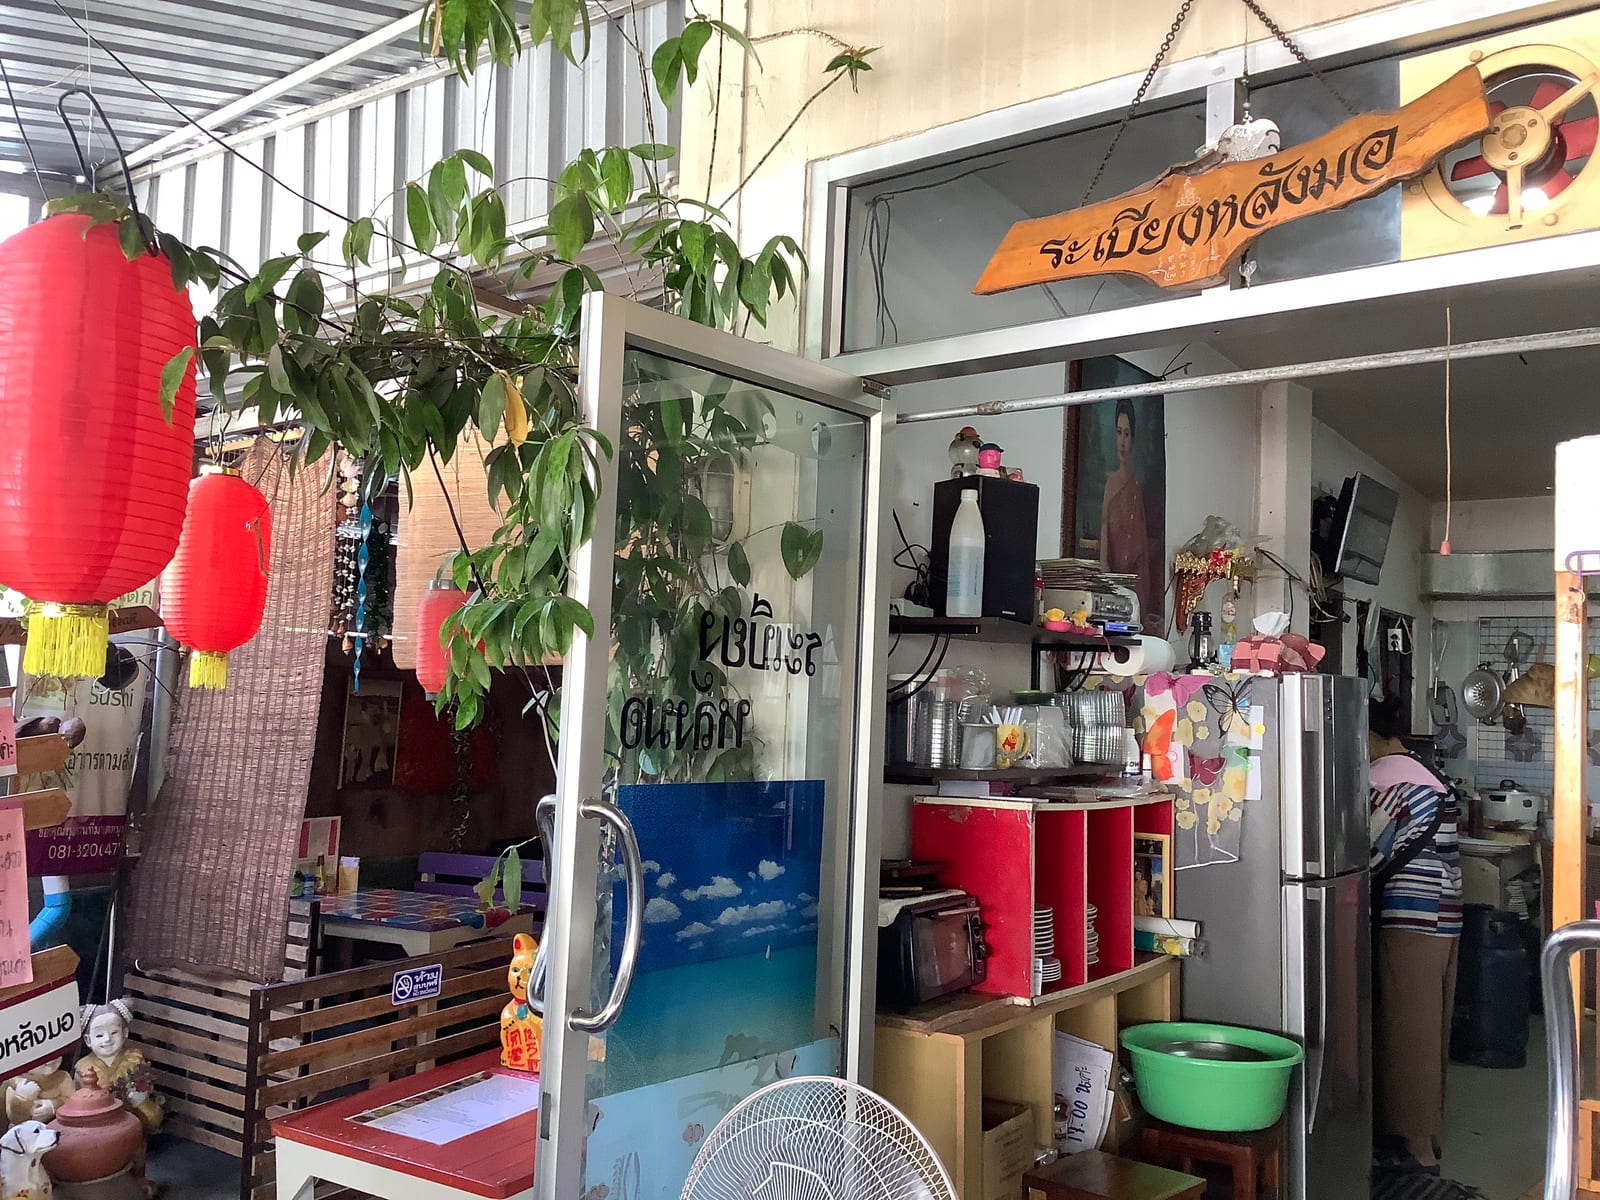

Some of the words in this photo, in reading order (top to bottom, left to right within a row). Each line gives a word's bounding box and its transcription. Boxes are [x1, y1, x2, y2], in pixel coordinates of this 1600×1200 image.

[1039, 125, 1400, 270] ระเบียงหลังมอ
